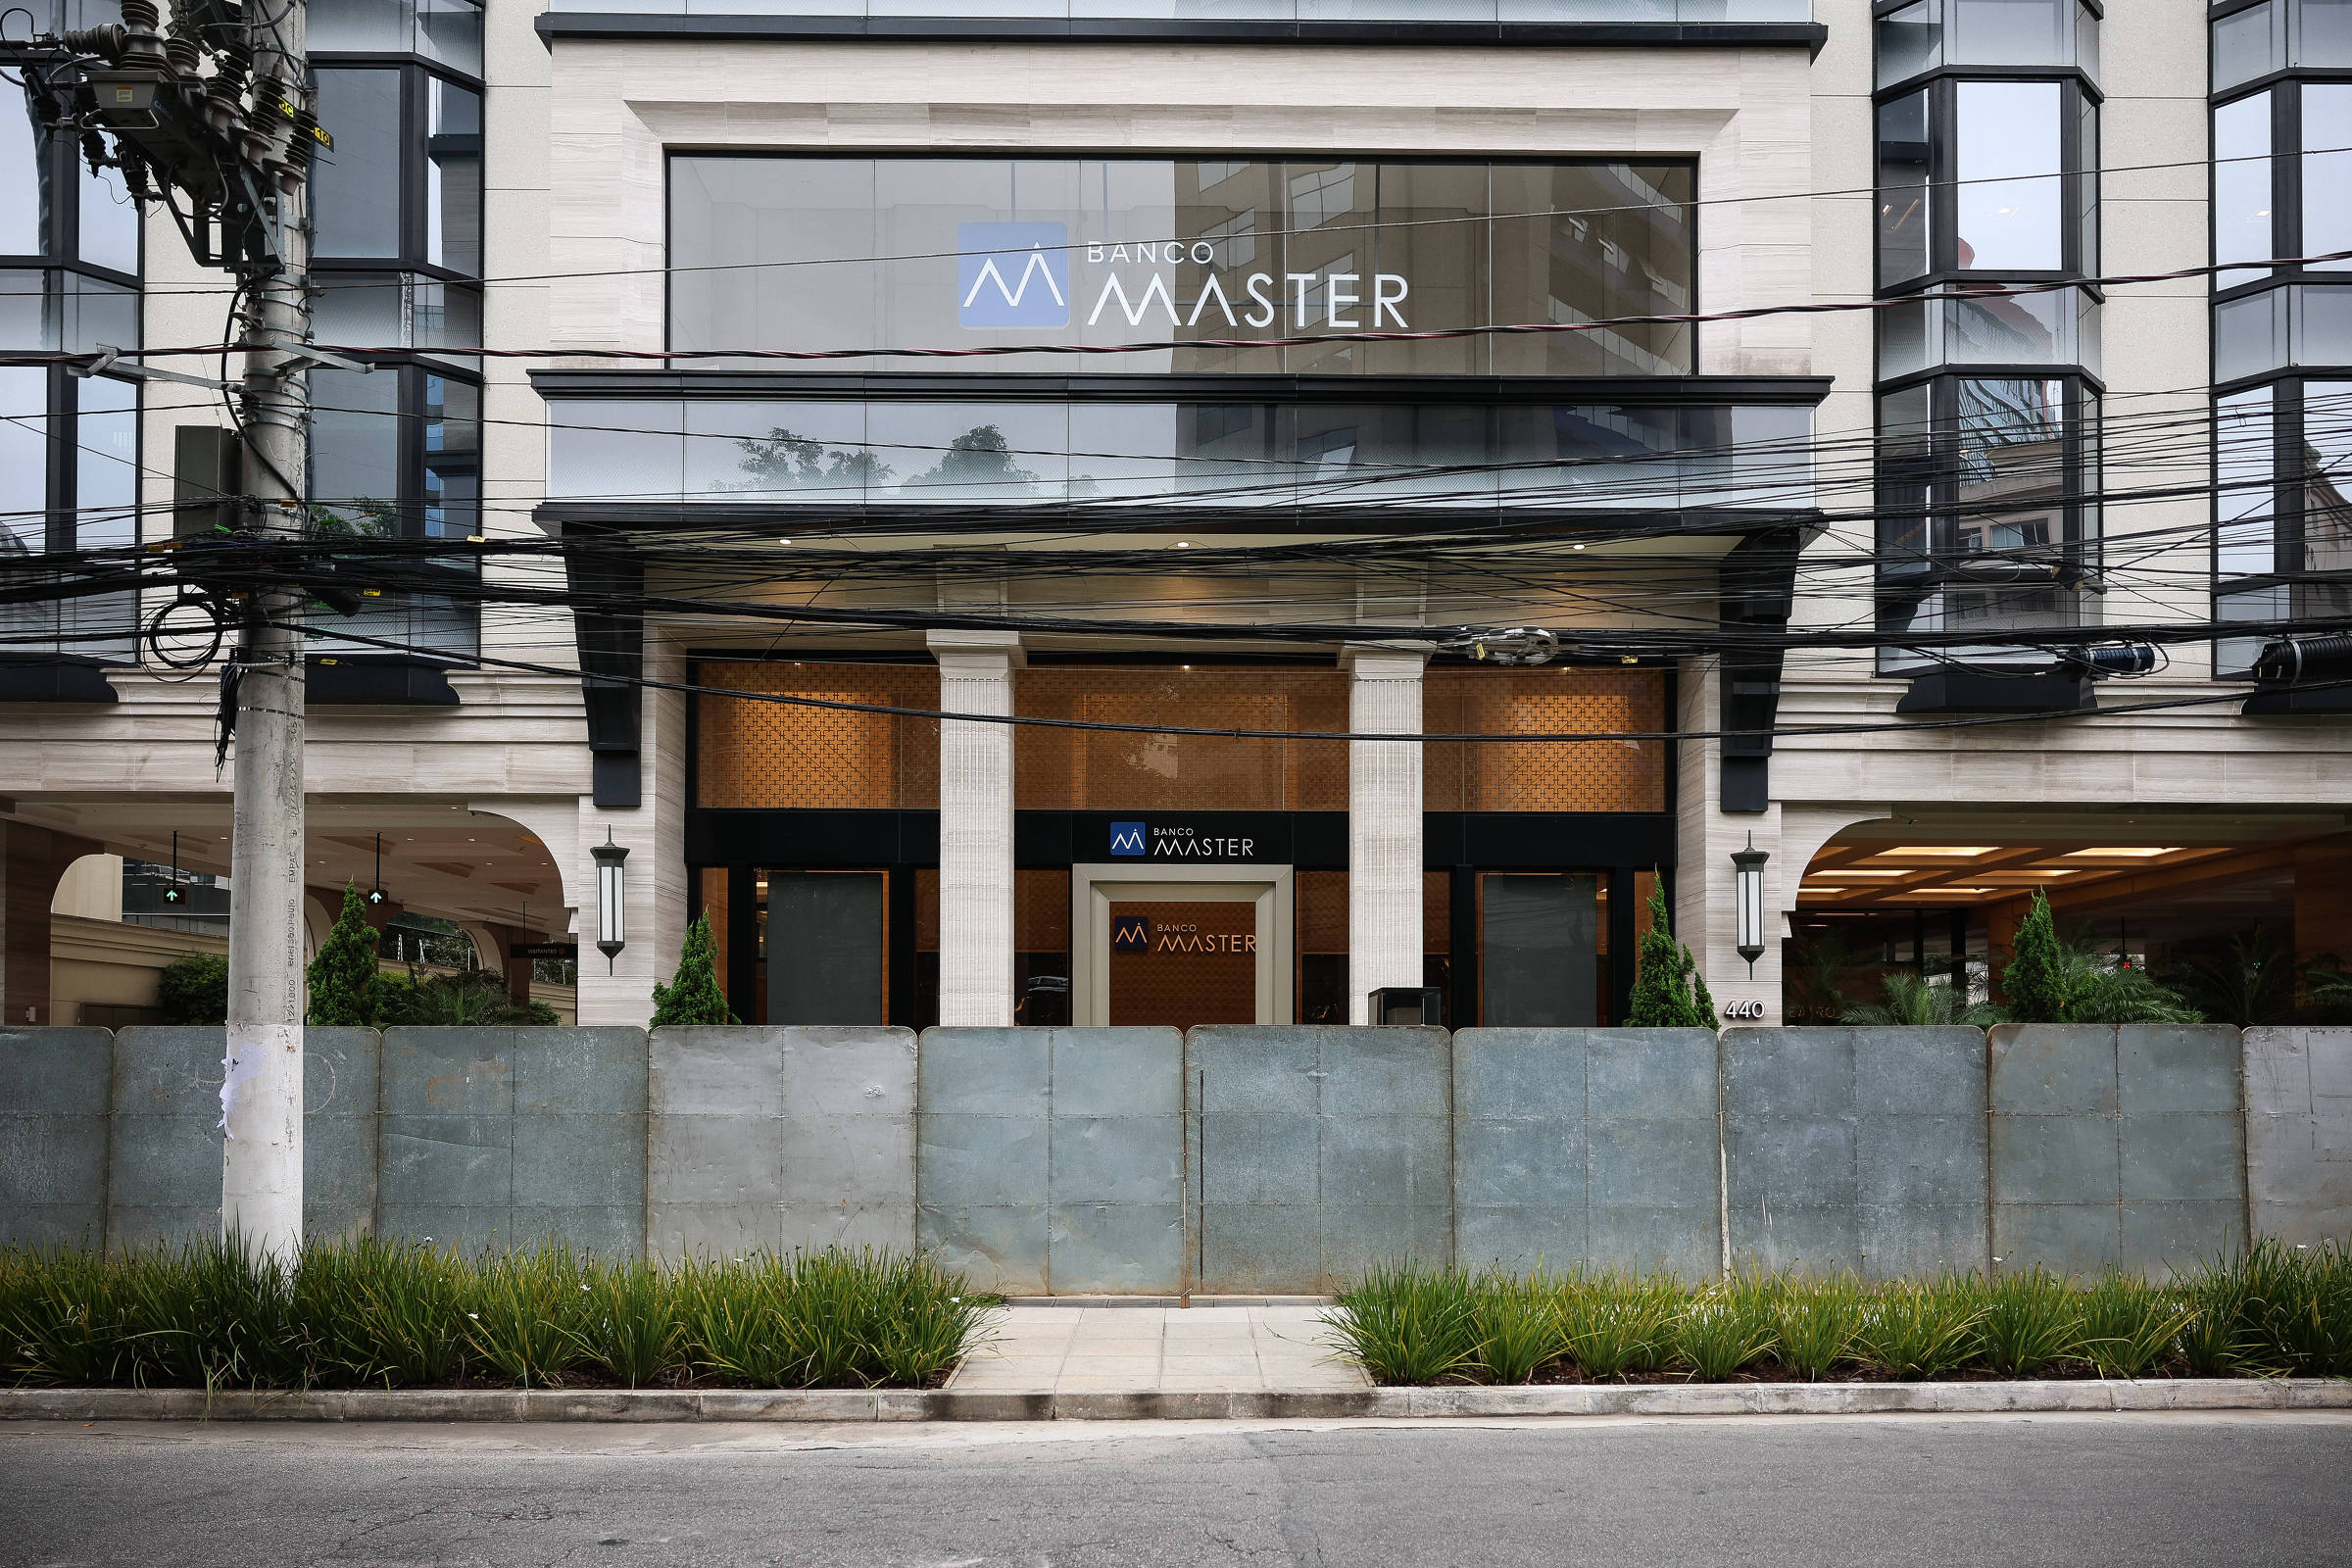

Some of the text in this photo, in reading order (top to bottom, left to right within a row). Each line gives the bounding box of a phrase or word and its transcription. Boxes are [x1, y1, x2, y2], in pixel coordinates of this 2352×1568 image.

[1088, 240, 1214, 264] BANCO
[1088, 271, 1409, 328] MASTER
[1153, 827, 1194, 836] BANCO
[1153, 838, 1254, 857] MASTER
[1156, 923, 1197, 932] BANCO
[1157, 934, 1255, 953] MASTER
[1725, 1001, 1765, 1018] 440
